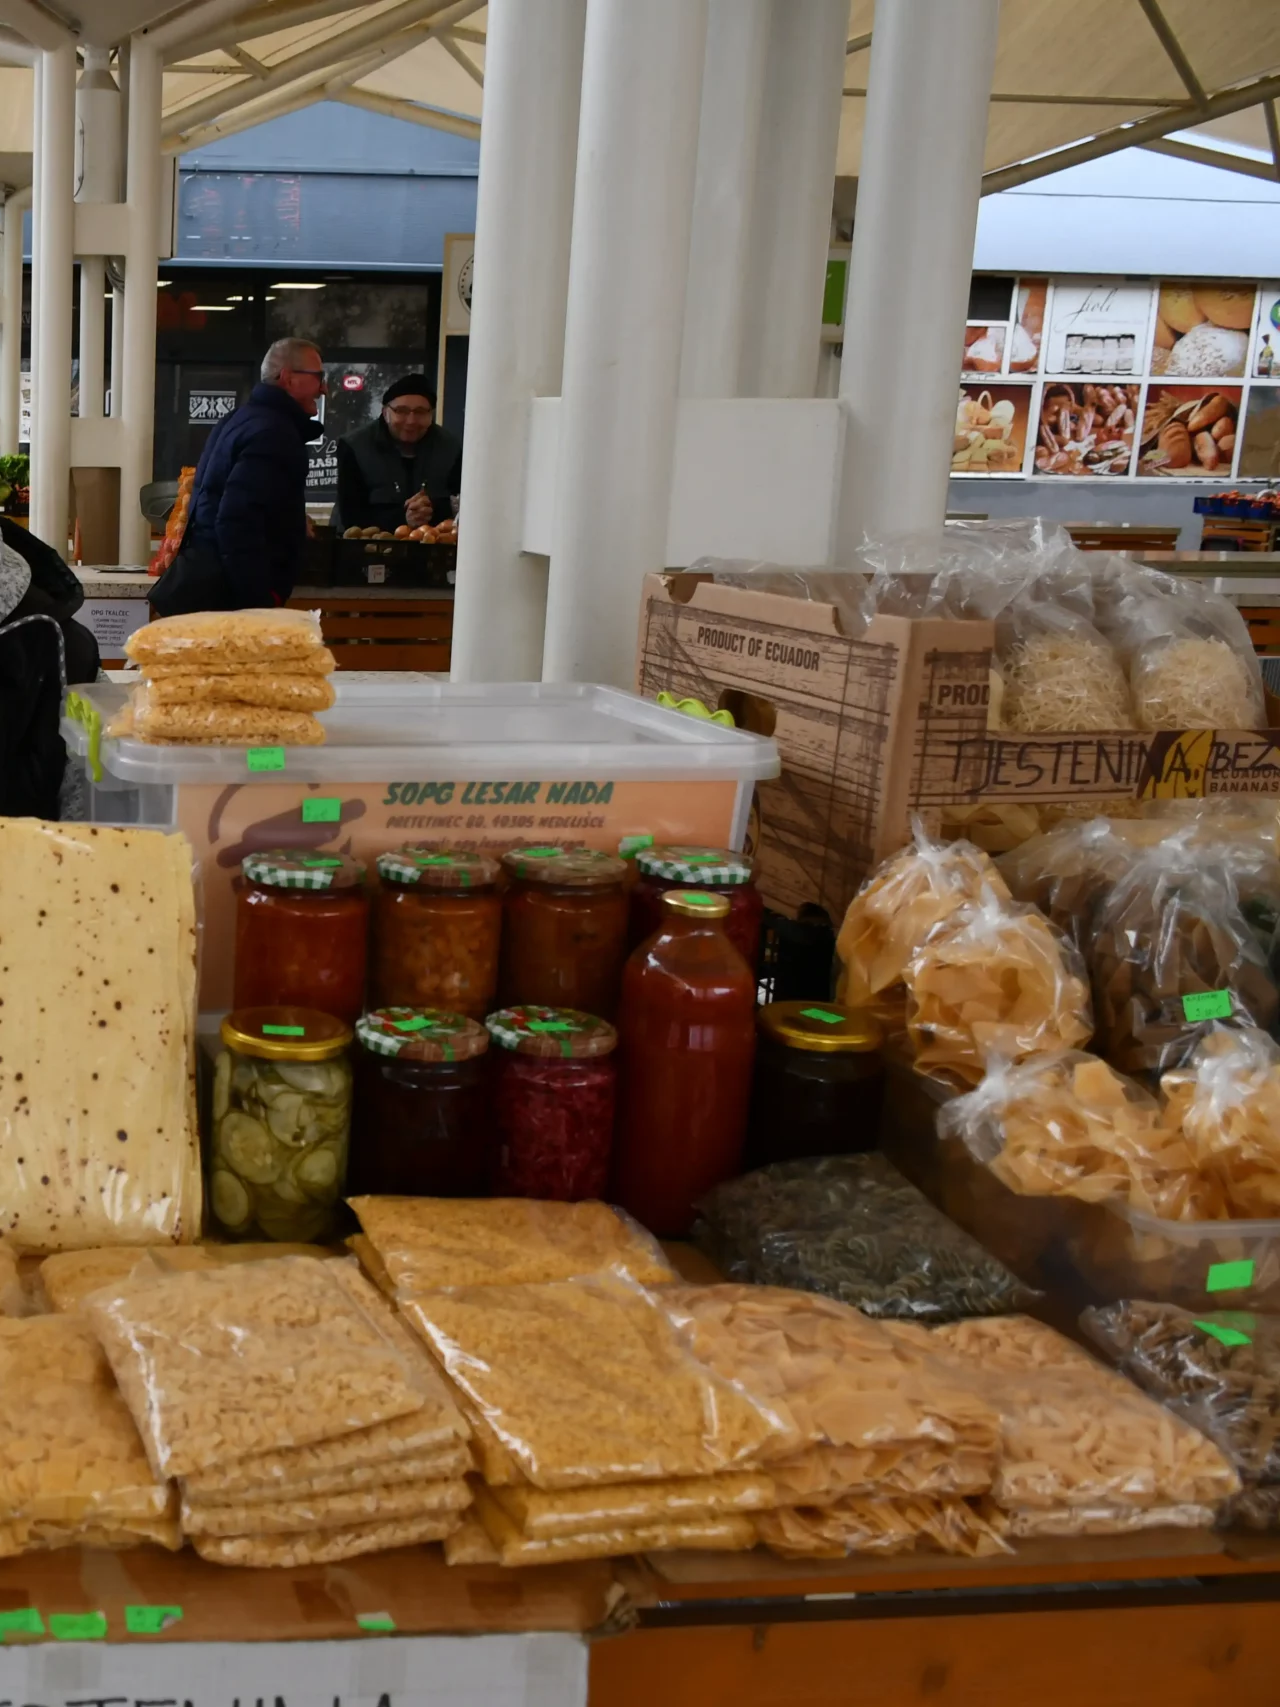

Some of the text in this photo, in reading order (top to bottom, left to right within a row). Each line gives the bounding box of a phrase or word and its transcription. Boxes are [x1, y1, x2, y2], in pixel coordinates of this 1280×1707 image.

[697, 626, 820, 672] PRODUCT OF ECUADOR
[945, 738, 1280, 795] TJESTENINA BEZ
[383, 781, 614, 806] SOPG LESAR NADA
[1210, 781, 1280, 793] BANANAS
